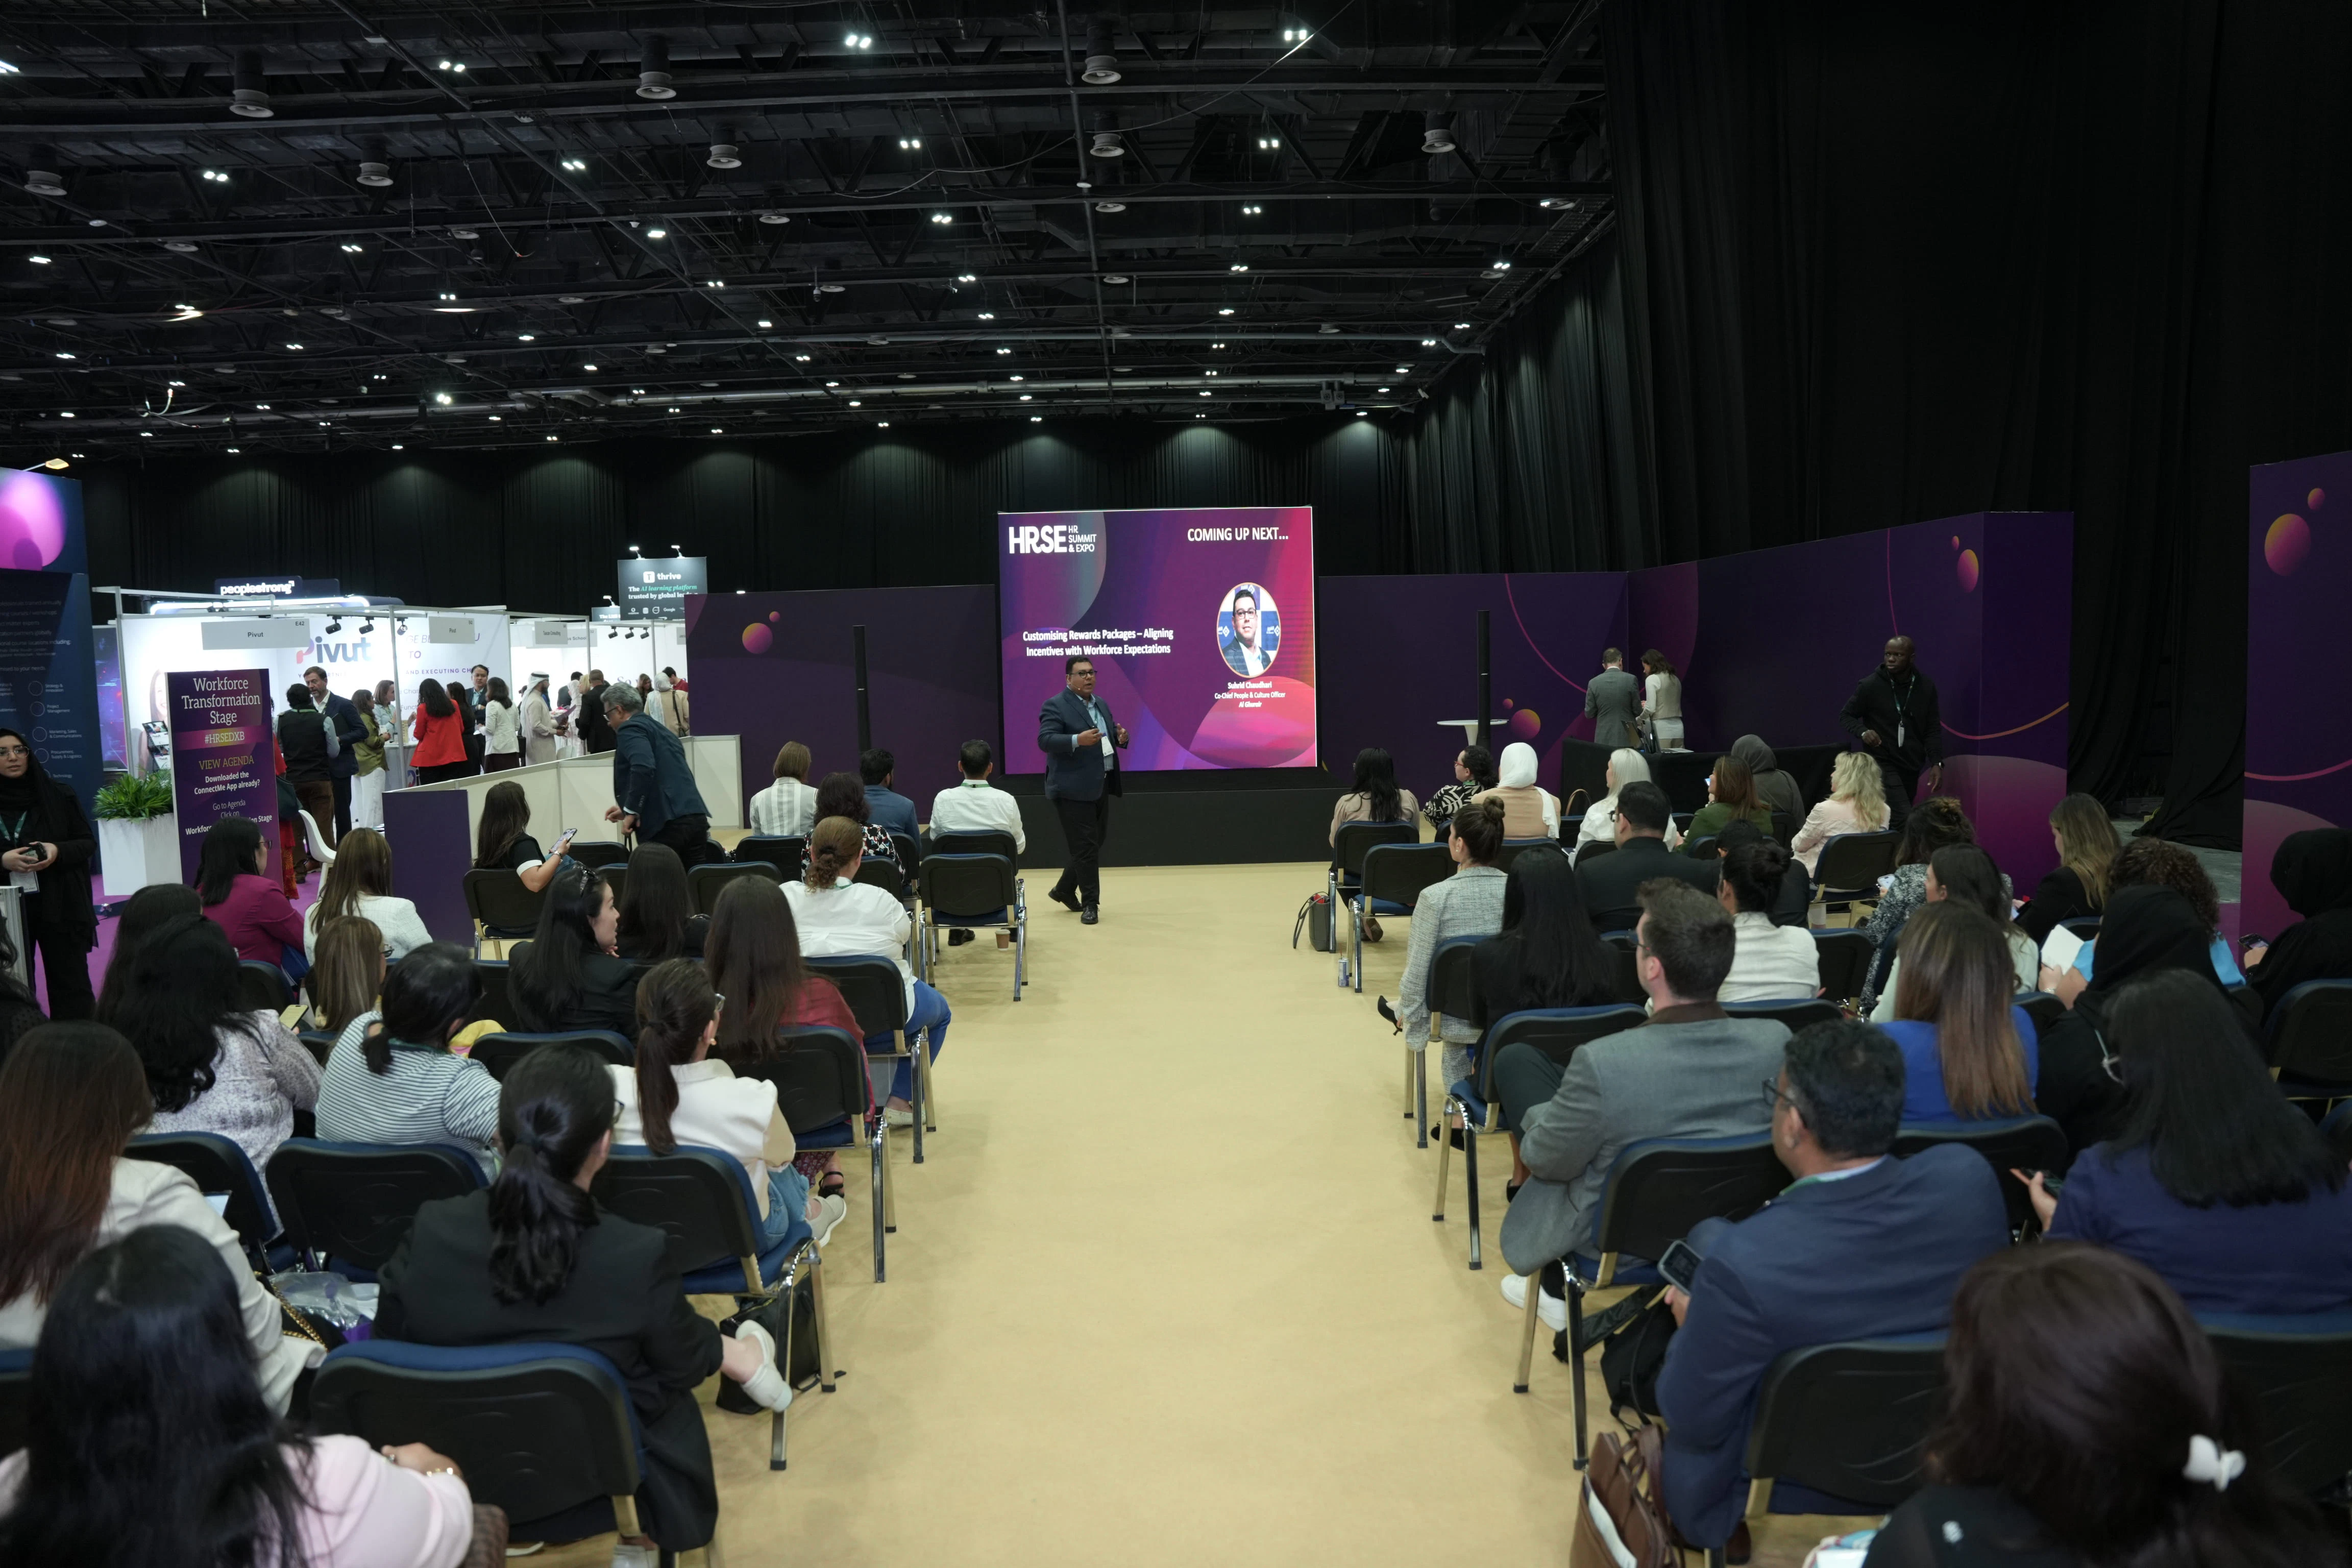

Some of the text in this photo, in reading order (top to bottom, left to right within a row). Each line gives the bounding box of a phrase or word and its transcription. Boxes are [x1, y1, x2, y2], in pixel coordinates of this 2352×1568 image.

[1068, 525, 1079, 533] HR
[1187, 527, 1288, 541] COMING UP NEXT...
[1009, 525, 1067, 554] HRSE
[1068, 534, 1097, 543] SUMMIT
[220, 582, 292, 596] peoplestrong
[1023, 631, 1068, 642] Customising
[1069, 629, 1101, 640] Rewards
[1102, 629, 1136, 641] Packages
[1143, 628, 1173, 640] Aligning
[1026, 644, 1171, 656] Incentives with Workforce Expectations
[193, 677, 249, 692] Workforce
[181, 692, 260, 709] Transformation
[210, 710, 237, 726] Stage
[205, 731, 245, 744] #HRSEDXB
[199, 755, 254, 770] VIEW AGENDA
[205, 772, 239, 783] Downloaded
[194, 779, 260, 794] ConnectMe App already?
[228, 799, 246, 810] Agenda
[221, 811, 232, 819] Click
